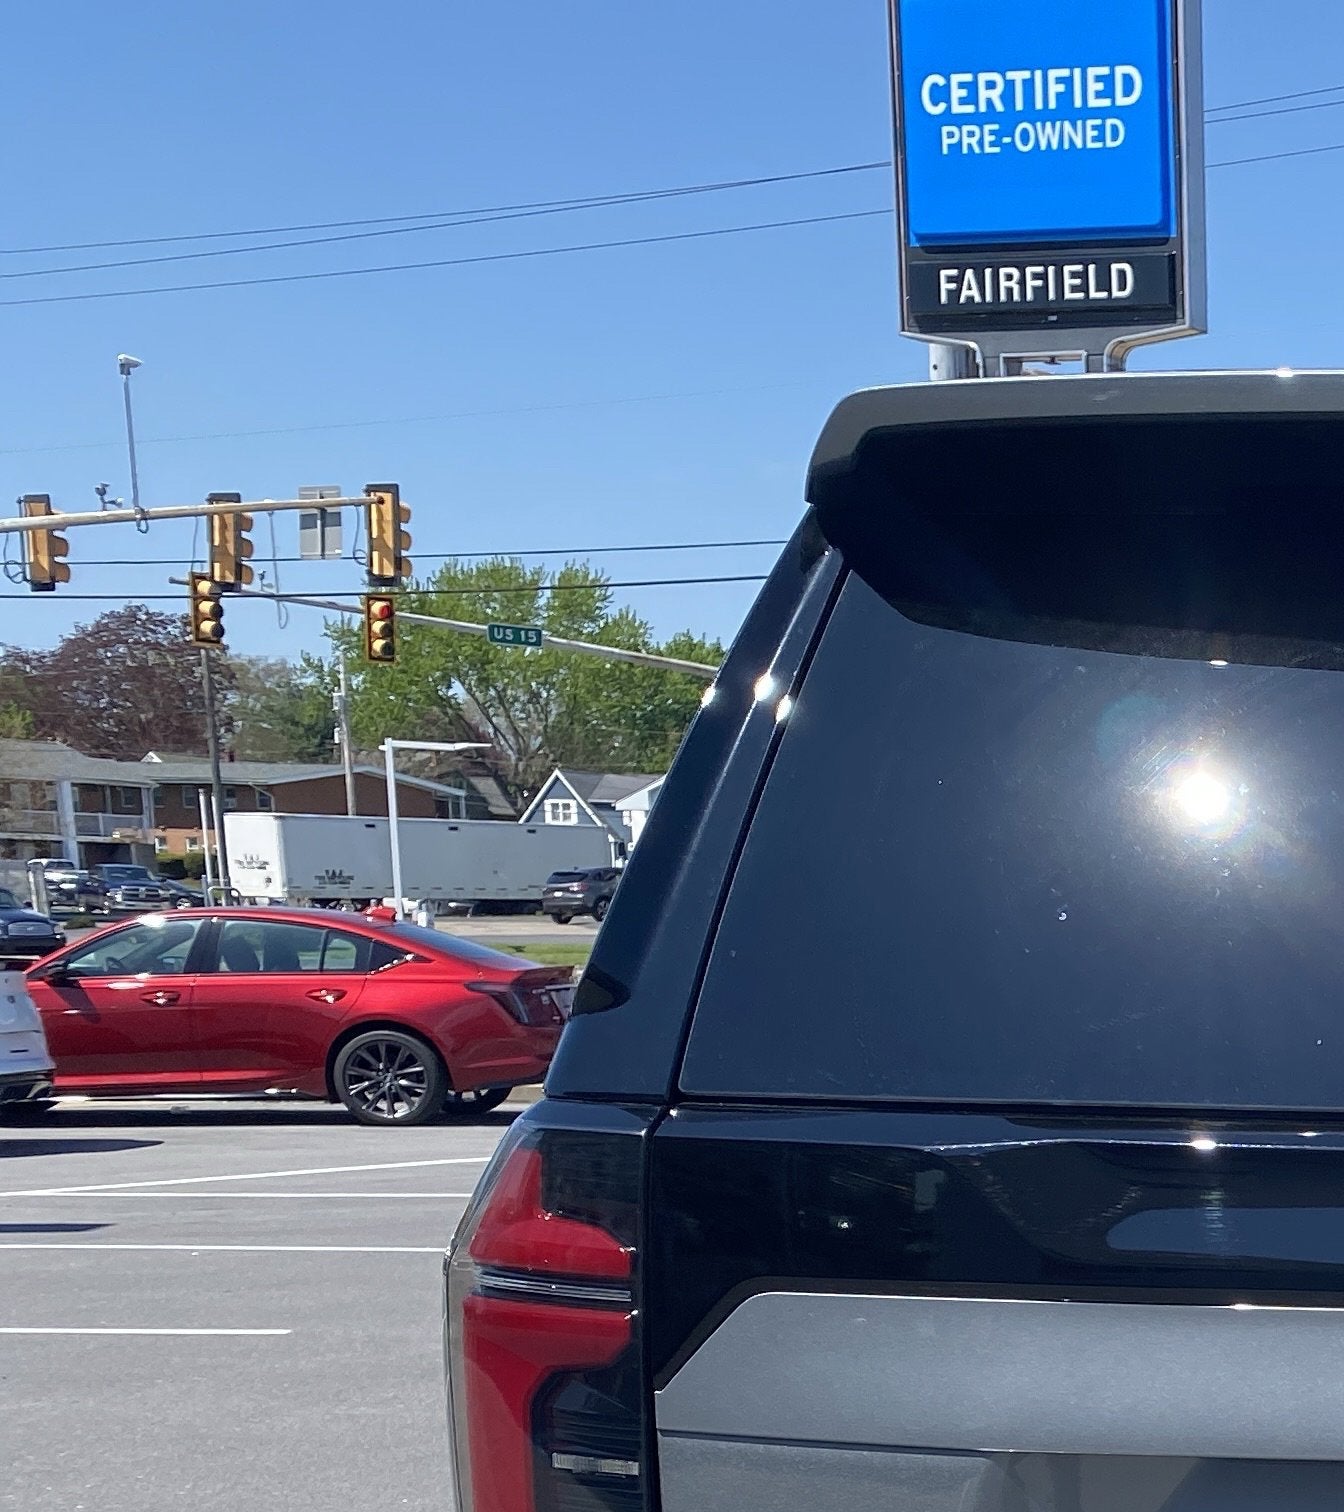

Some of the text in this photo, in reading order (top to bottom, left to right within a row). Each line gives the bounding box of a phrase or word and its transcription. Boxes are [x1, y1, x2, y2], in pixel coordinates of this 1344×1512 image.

[921, 65, 1142, 115] CERTIFIED
[941, 118, 1125, 155] PRE-OWNED
[939, 262, 1134, 304] FAIRFIELD
[493, 627, 537, 643] US 15
